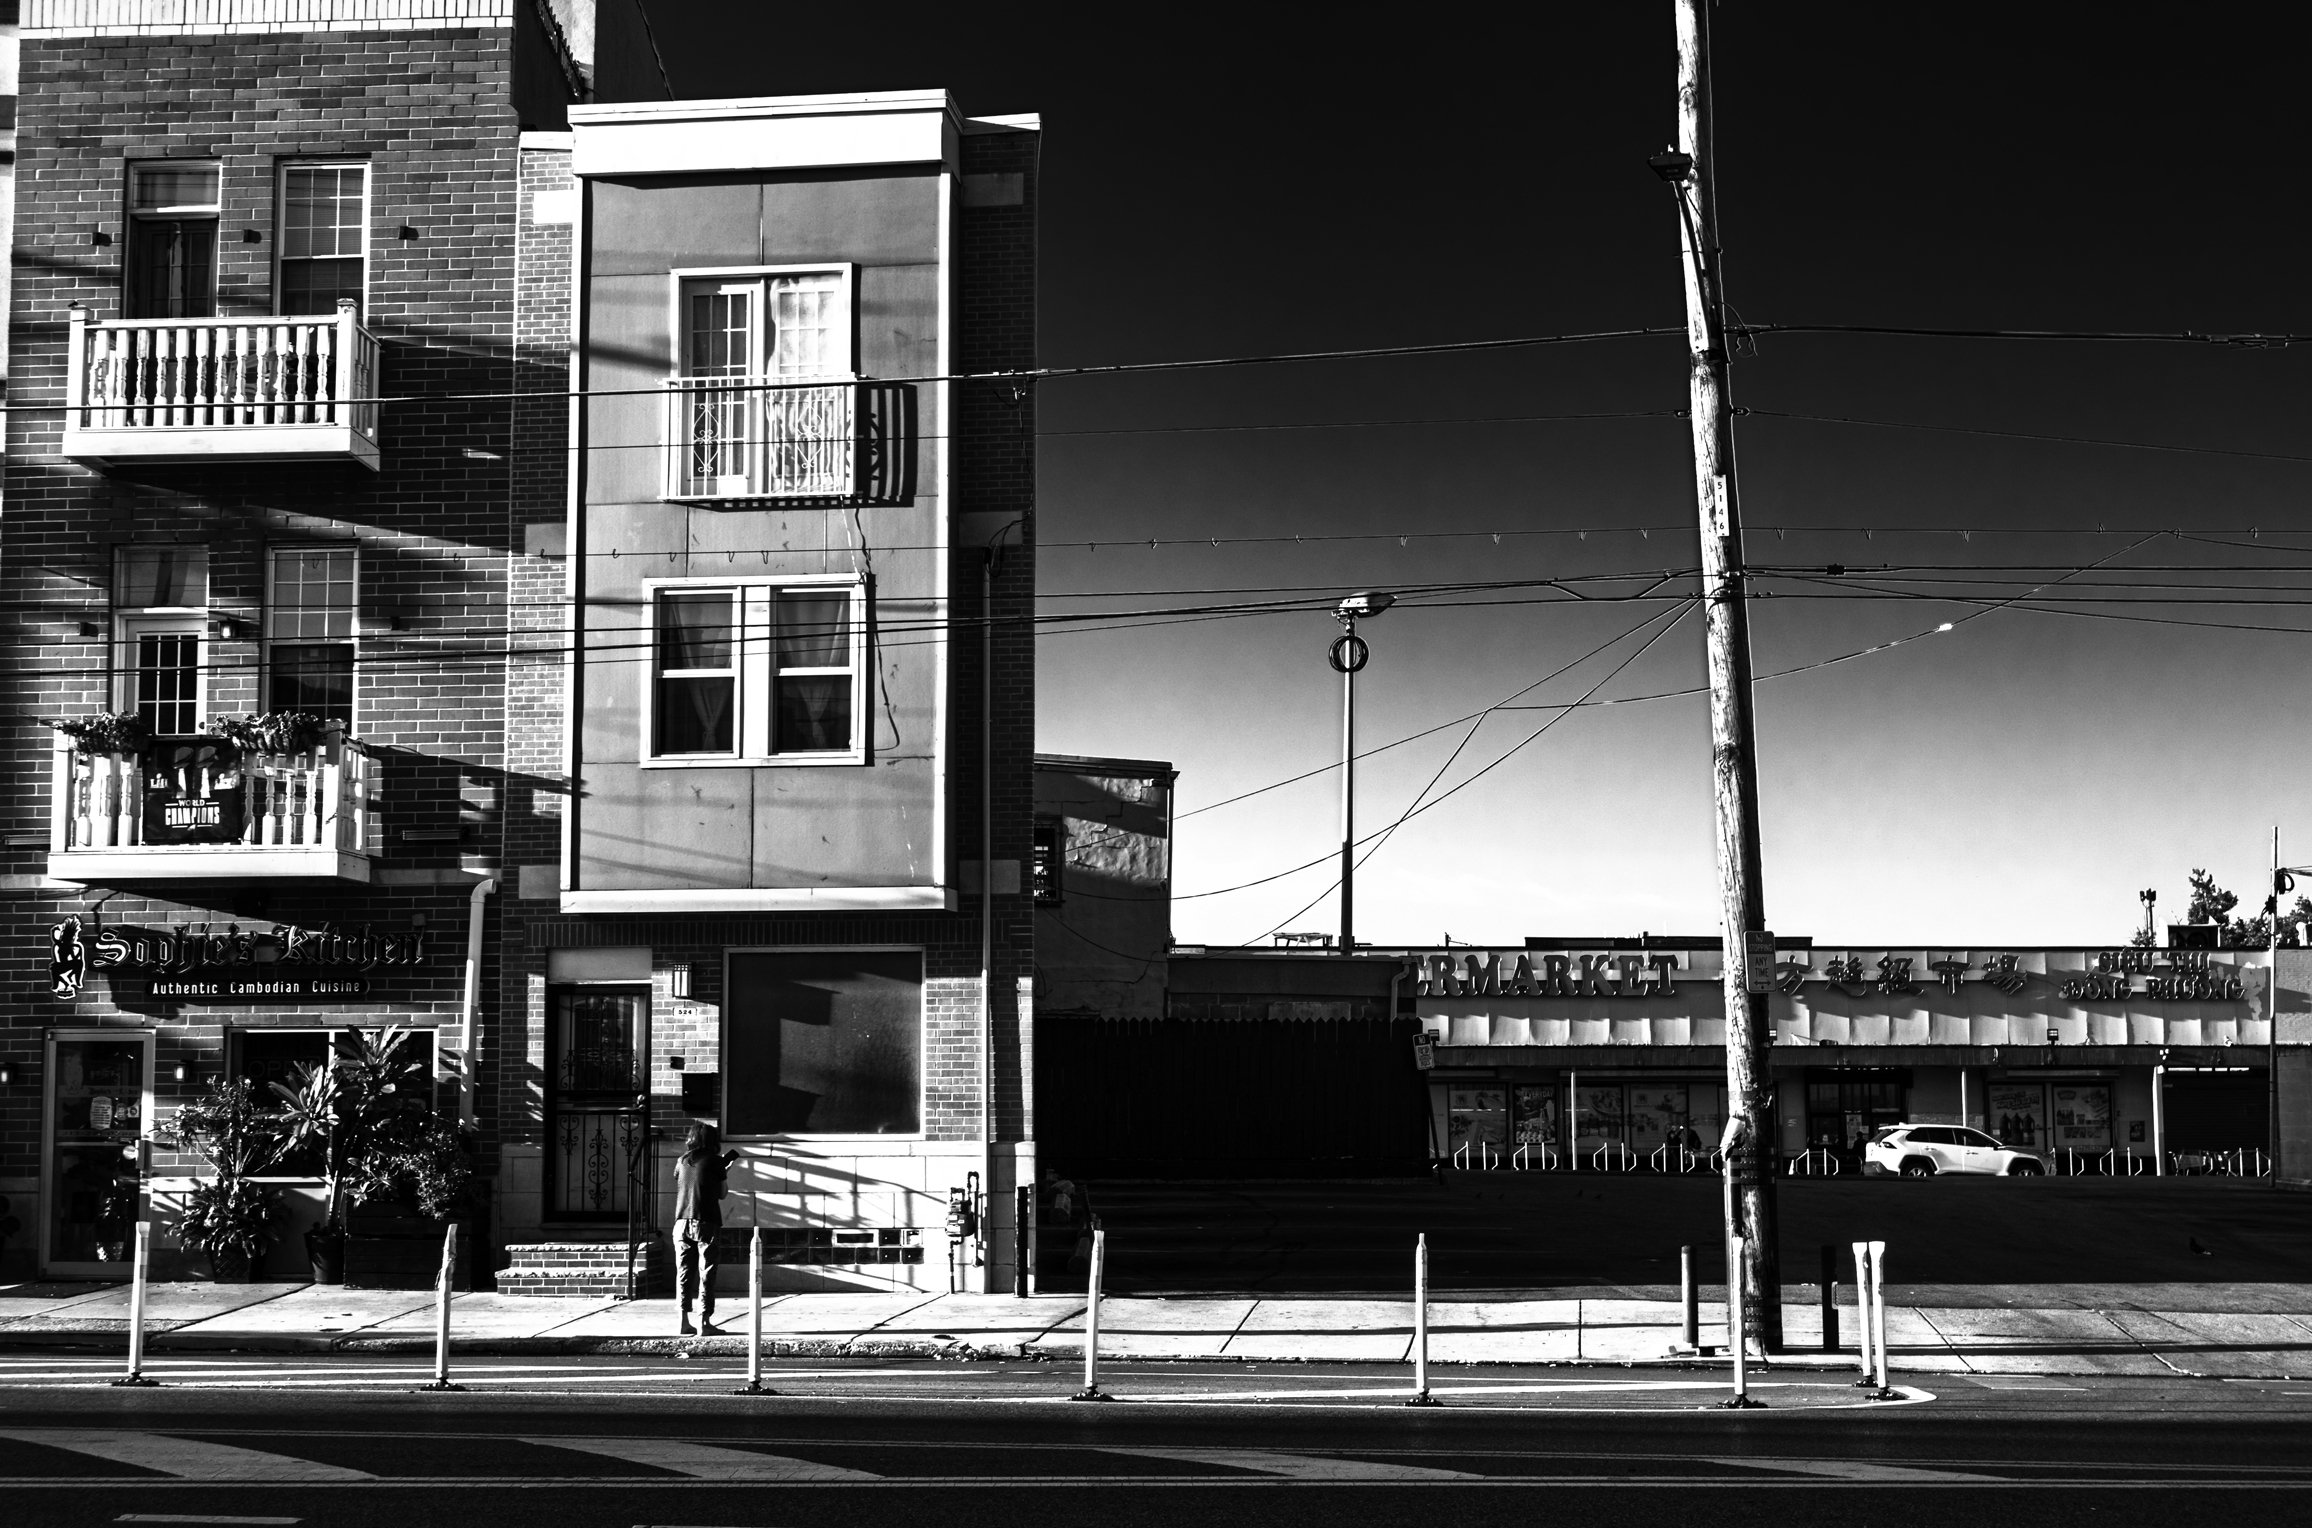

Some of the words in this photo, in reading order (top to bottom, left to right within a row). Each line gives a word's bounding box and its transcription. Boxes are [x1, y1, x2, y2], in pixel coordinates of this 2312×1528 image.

[178, 799, 205, 807] WORLD
[165, 806, 220, 826] CHAMPIONS
[1755, 933, 1764, 943] NO
[92, 923, 259, 974] Sophie's
[271, 920, 425, 973] Kitchen
[1755, 956, 1768, 967] ANY
[1755, 967, 1769, 978] TIME
[151, 980, 218, 996] Authentic
[229, 979, 301, 995] Cambodian
[311, 979, 361, 994] Cuisine
